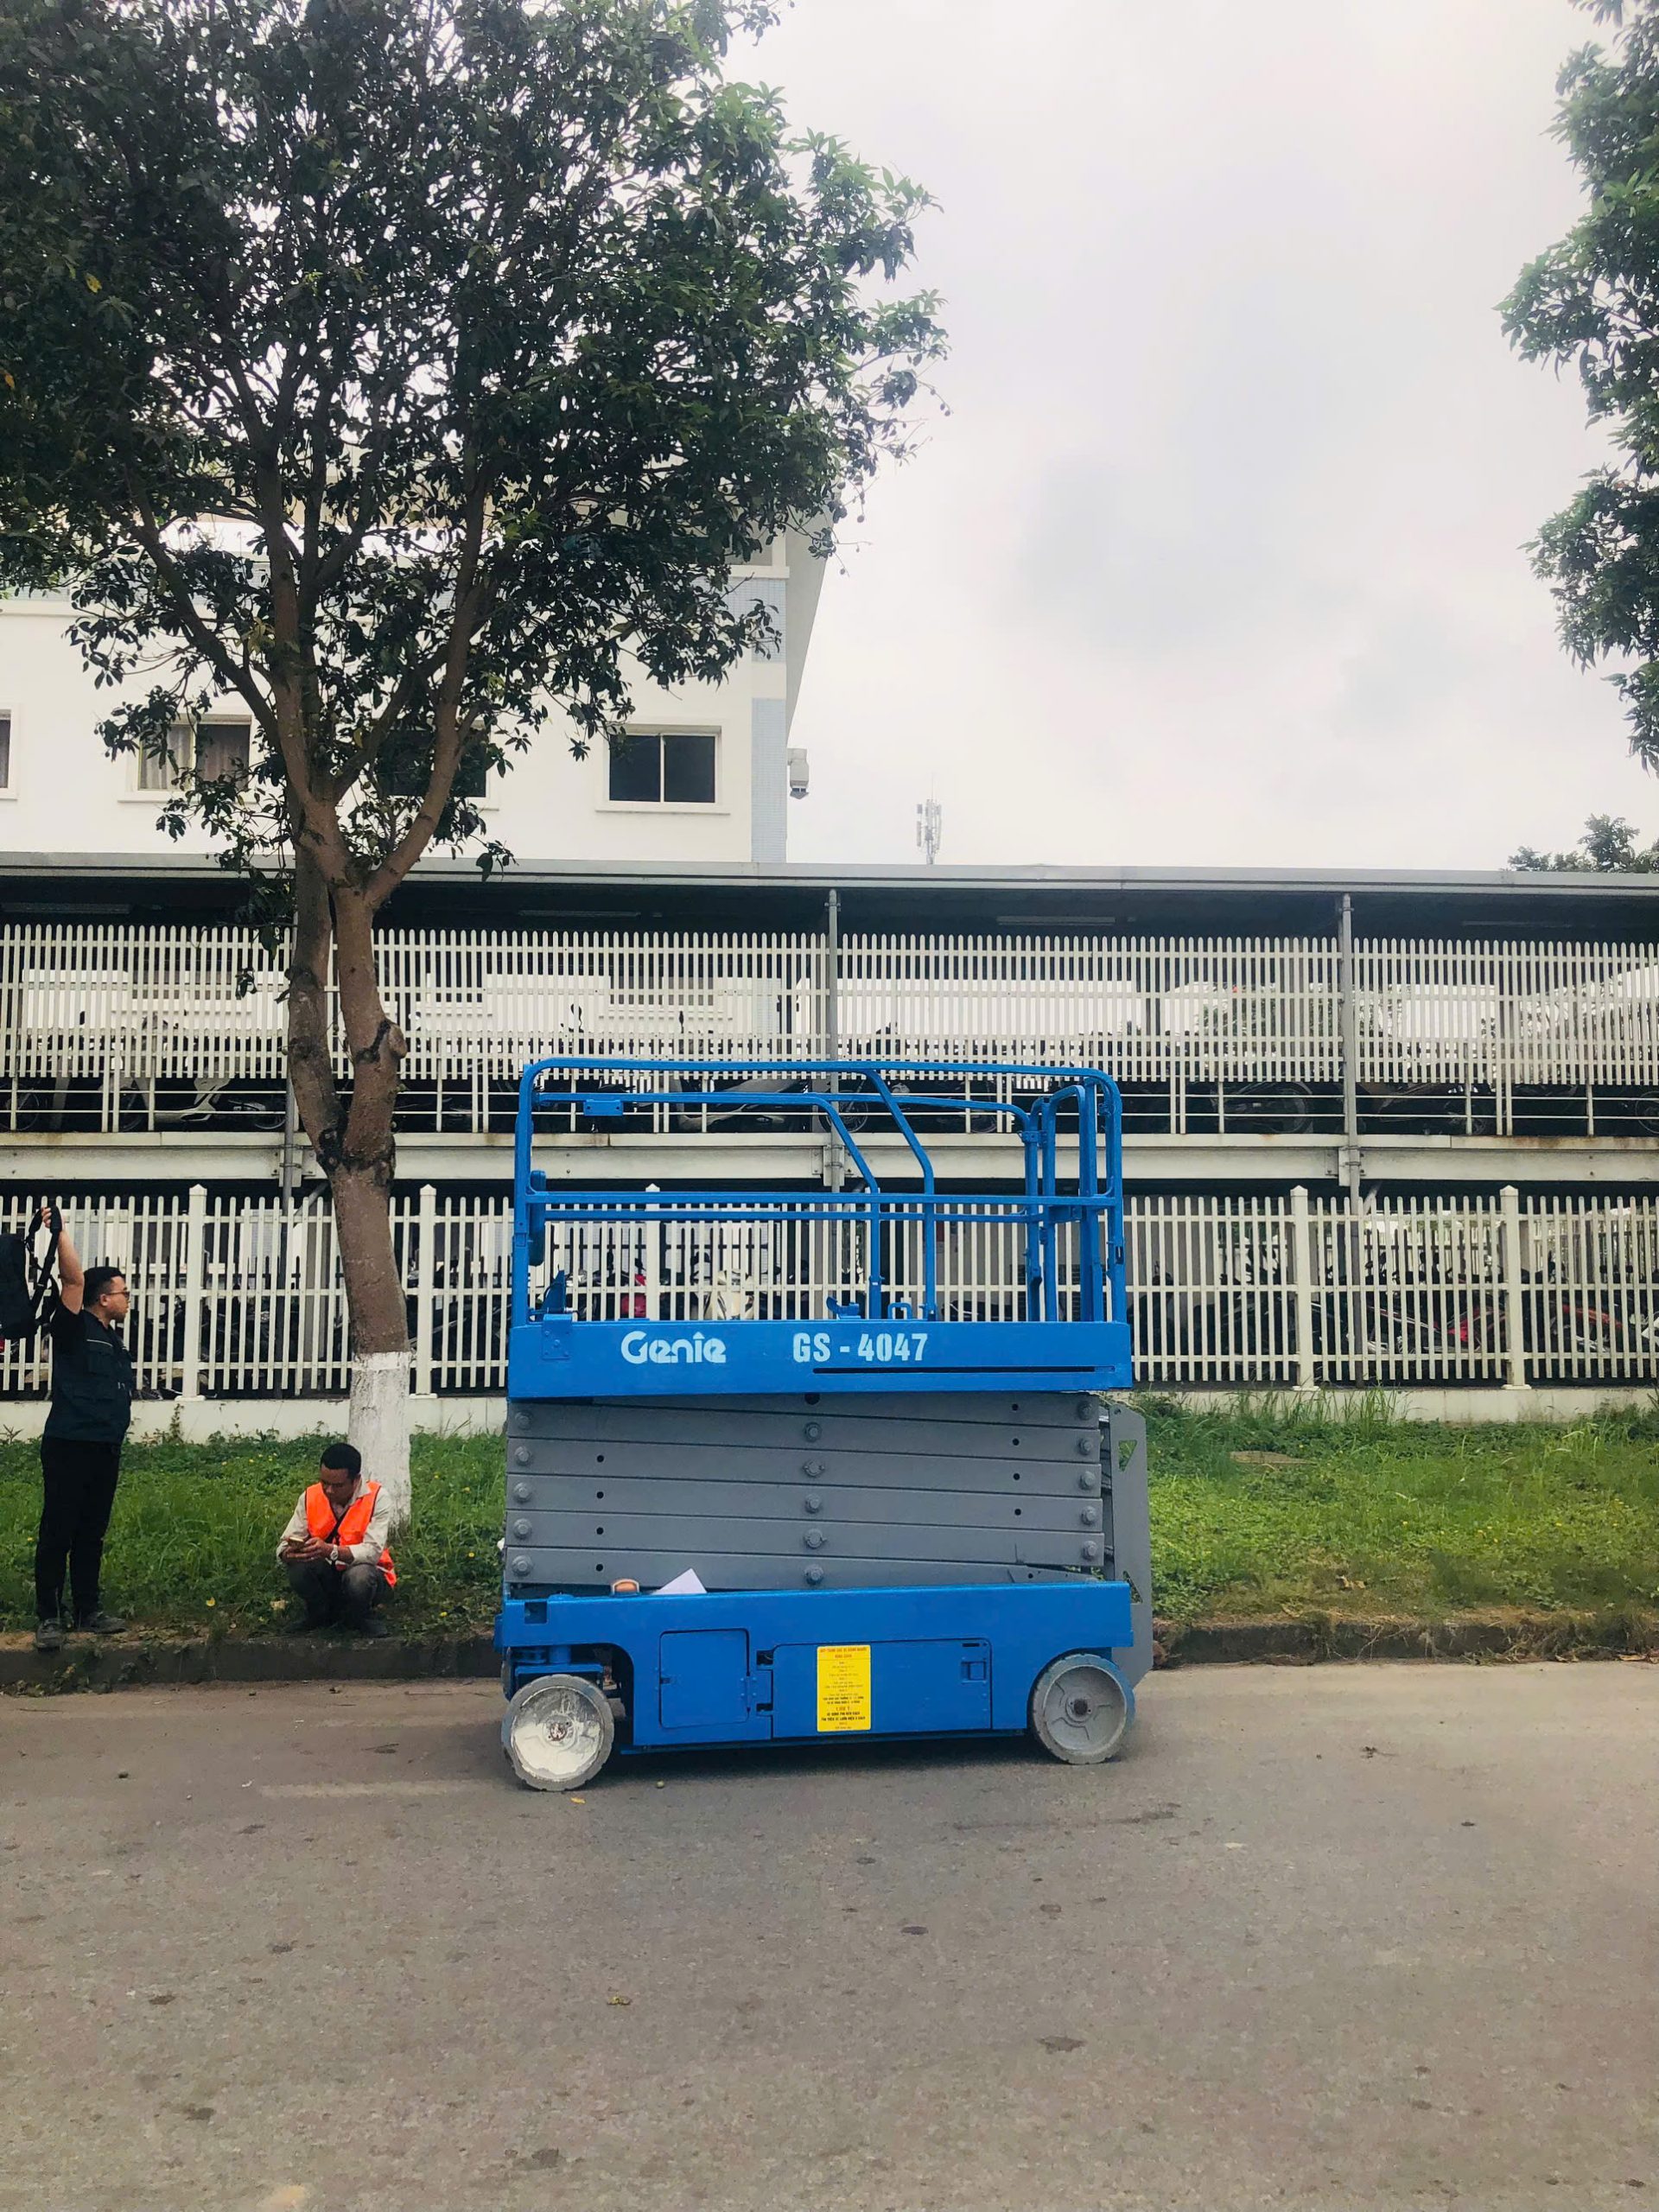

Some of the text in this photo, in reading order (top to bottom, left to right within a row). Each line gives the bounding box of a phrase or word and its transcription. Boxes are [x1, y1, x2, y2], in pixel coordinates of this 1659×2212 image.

[620, 1331, 727, 1364] Genie
[793, 1332, 830, 1363] GS
[857, 1333, 928, 1362] 4047
